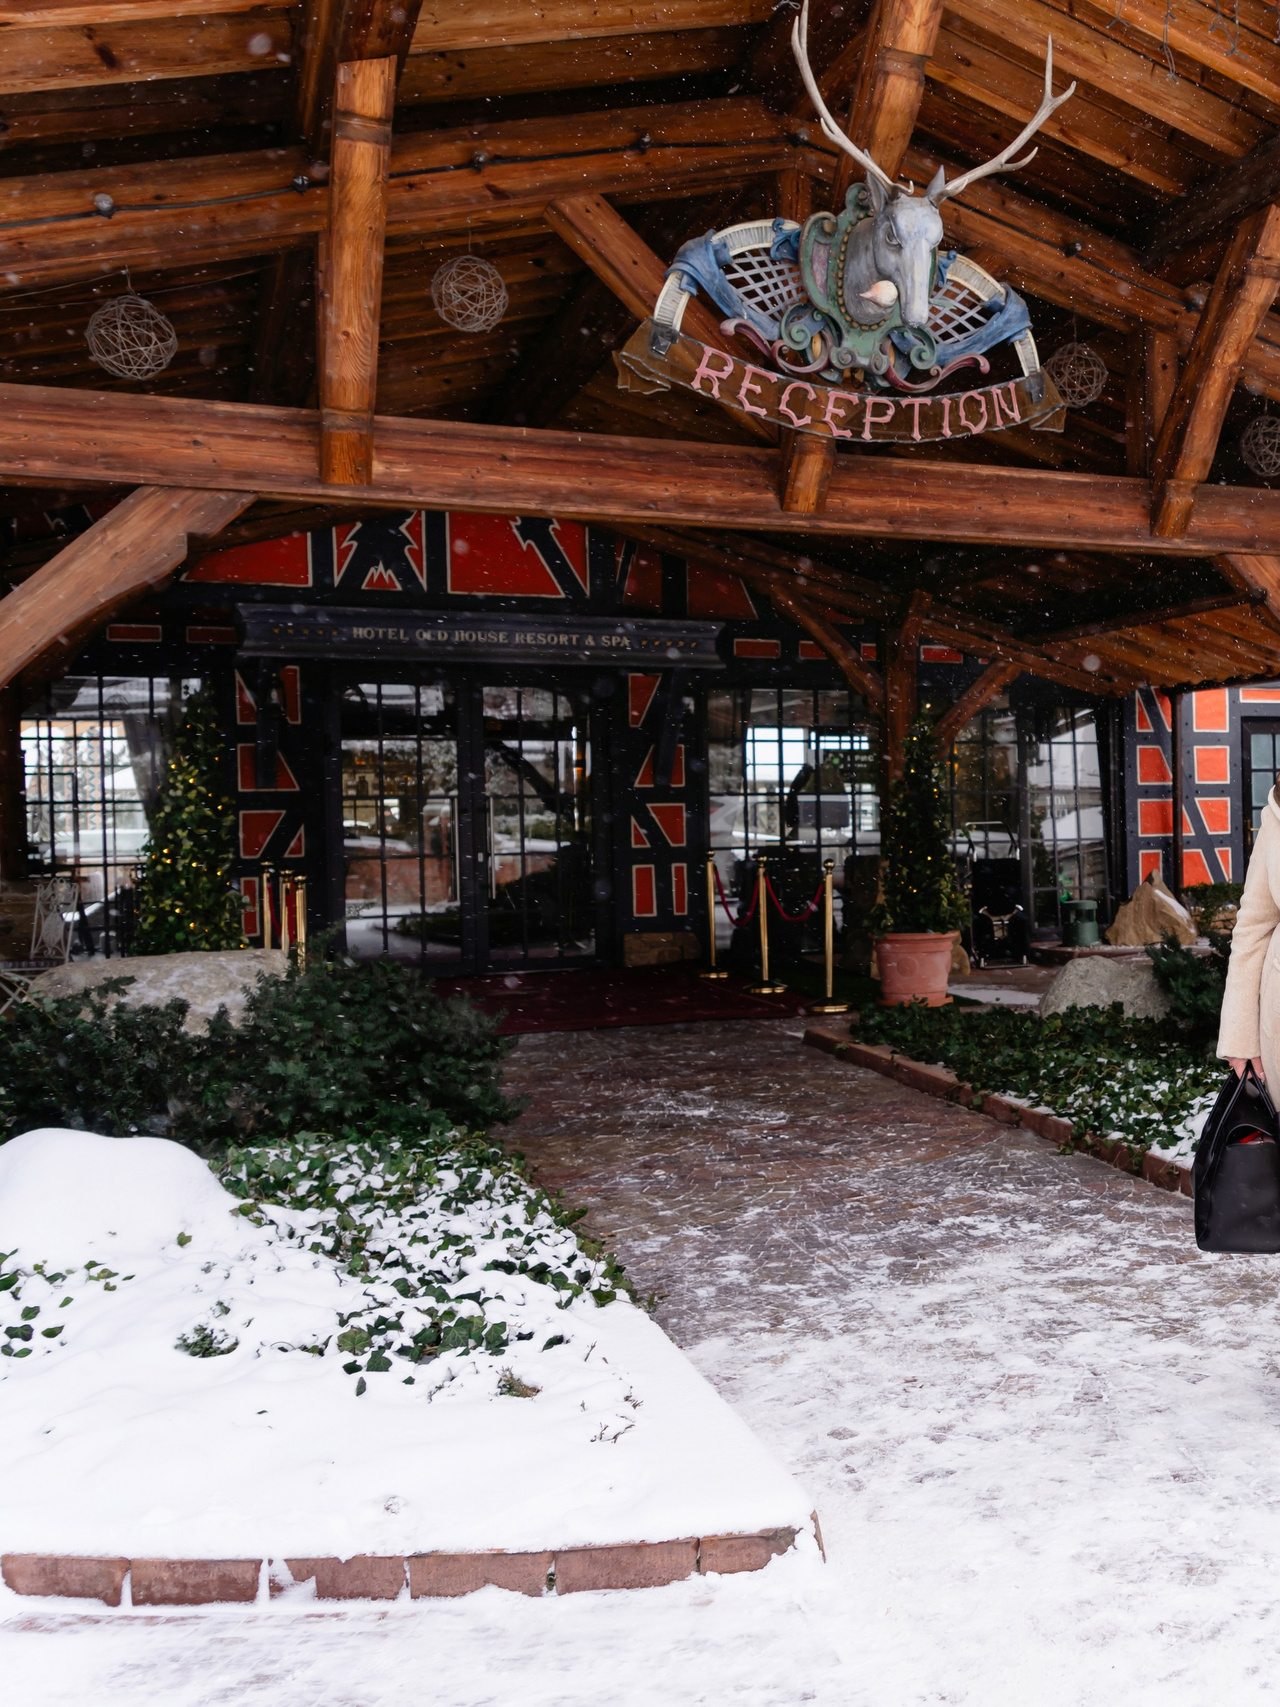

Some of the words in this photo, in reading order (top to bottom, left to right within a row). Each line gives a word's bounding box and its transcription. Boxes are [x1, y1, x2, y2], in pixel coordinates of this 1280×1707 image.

[690, 345, 1022, 441] RECEPTION
[352, 626, 410, 641] HOTEL
[415, 628, 448, 642] OLD
[454, 629, 508, 644] HOUSE
[514, 631, 579, 646] RESORT
[601, 634, 630, 647] SPA
